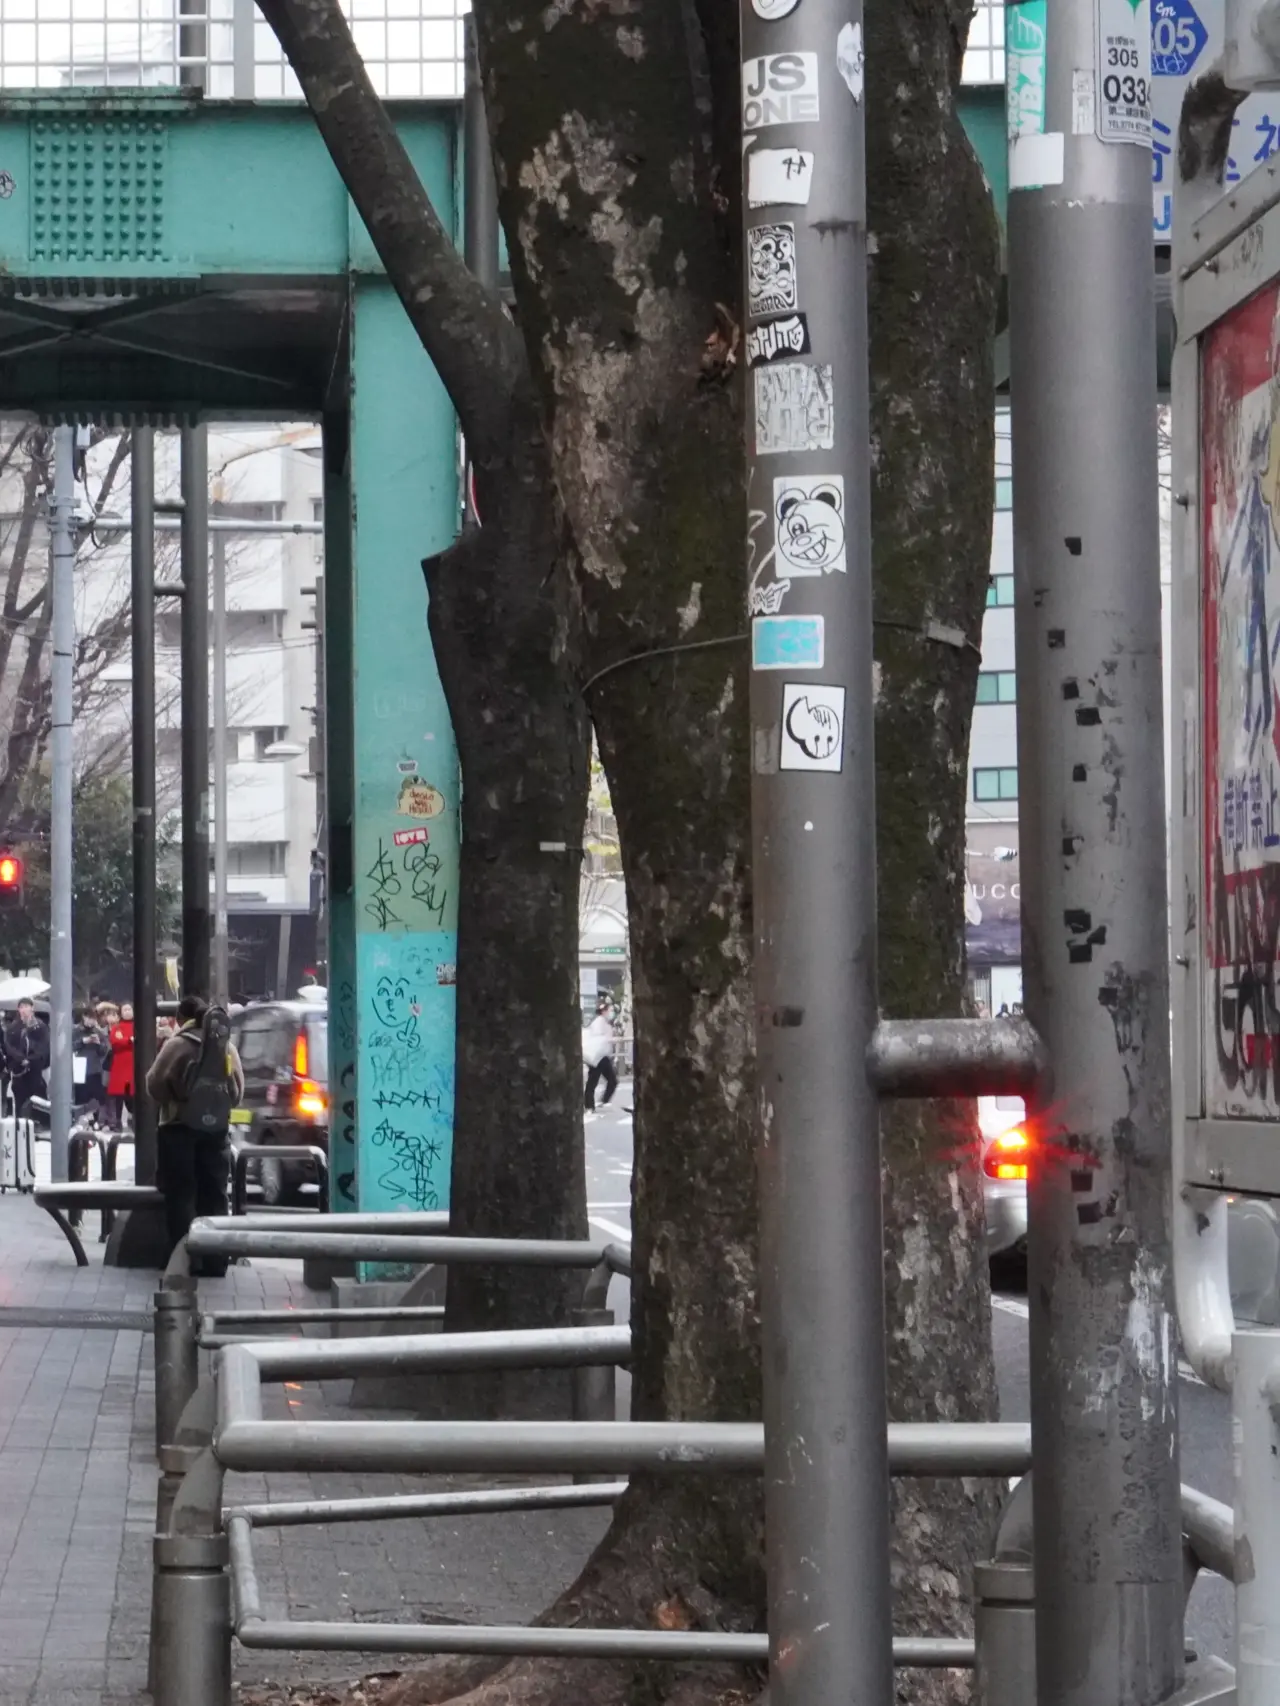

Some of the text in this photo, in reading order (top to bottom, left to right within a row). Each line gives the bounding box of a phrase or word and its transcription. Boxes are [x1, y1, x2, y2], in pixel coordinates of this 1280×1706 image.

[1151, 17, 1196, 56] 05
[1107, 47, 1138, 69] 305
[747, 54, 806, 97] JS
[744, 94, 817, 128] ONE
[972, 883, 1020, 900] UCC
